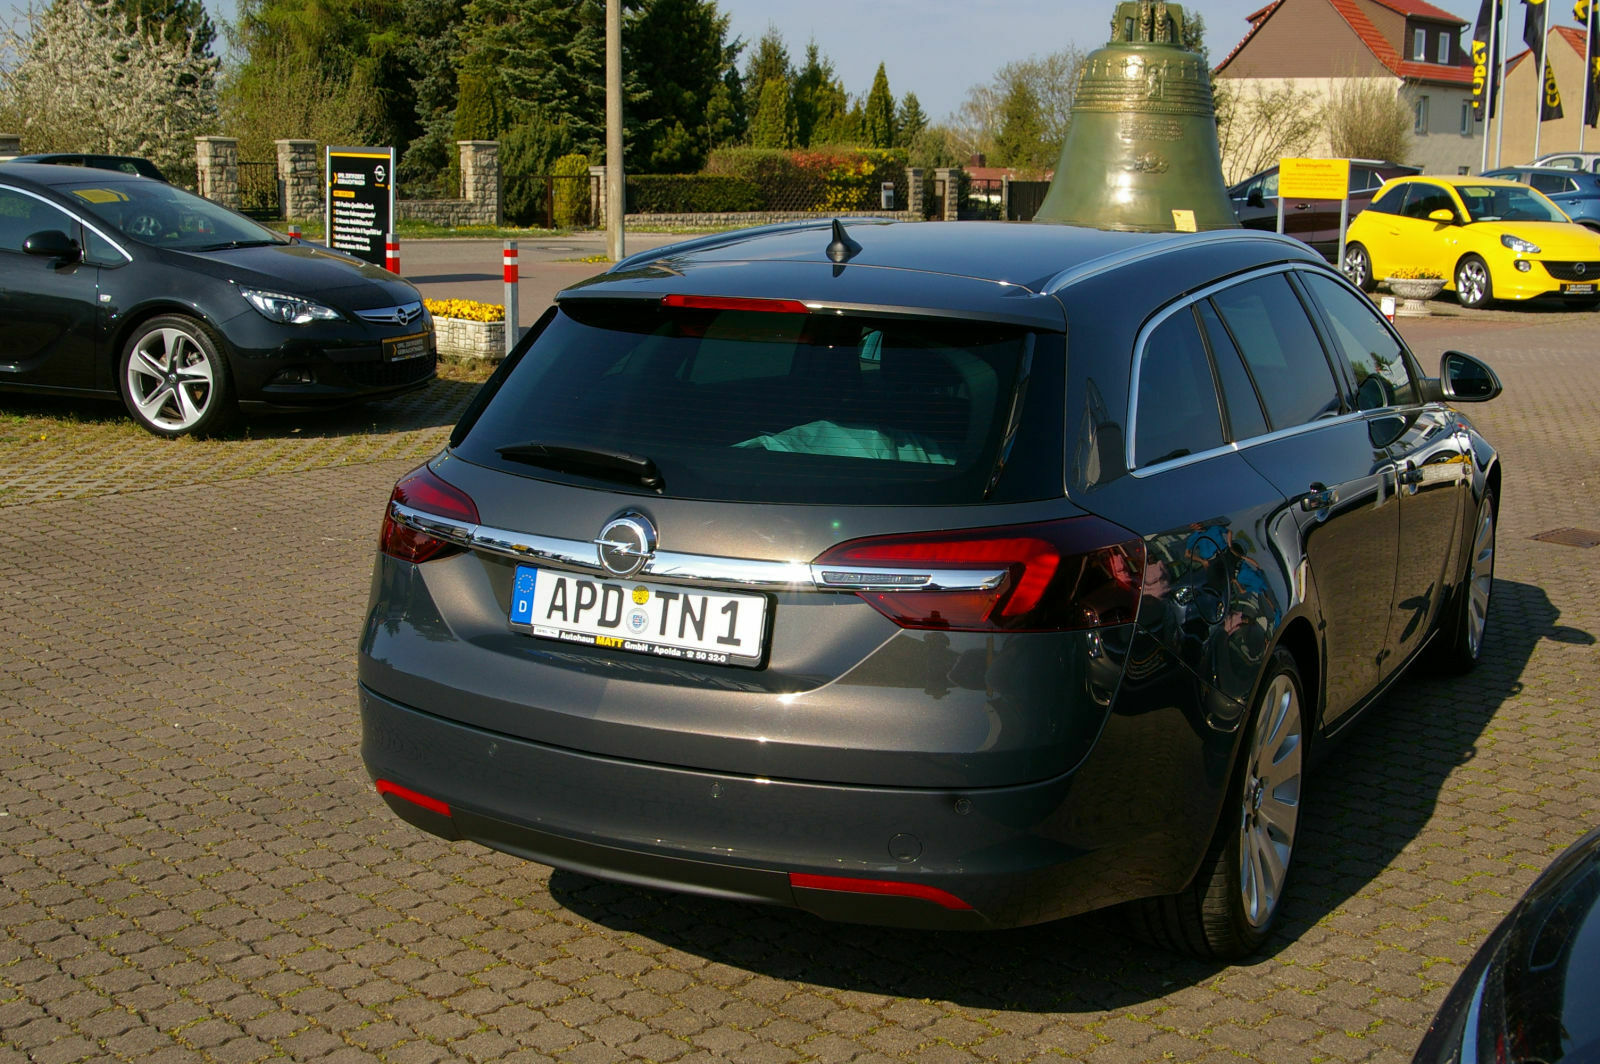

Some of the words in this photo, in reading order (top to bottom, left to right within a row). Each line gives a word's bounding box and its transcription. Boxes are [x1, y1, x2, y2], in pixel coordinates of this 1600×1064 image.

[518, 600, 528, 613] D
[547, 577, 625, 629] APD
[560, 631, 595, 644] Autohaus
[595, 635, 624, 648] MATT
[624, 640, 649, 652] GmbH
[653, 645, 682, 657] Apolda
